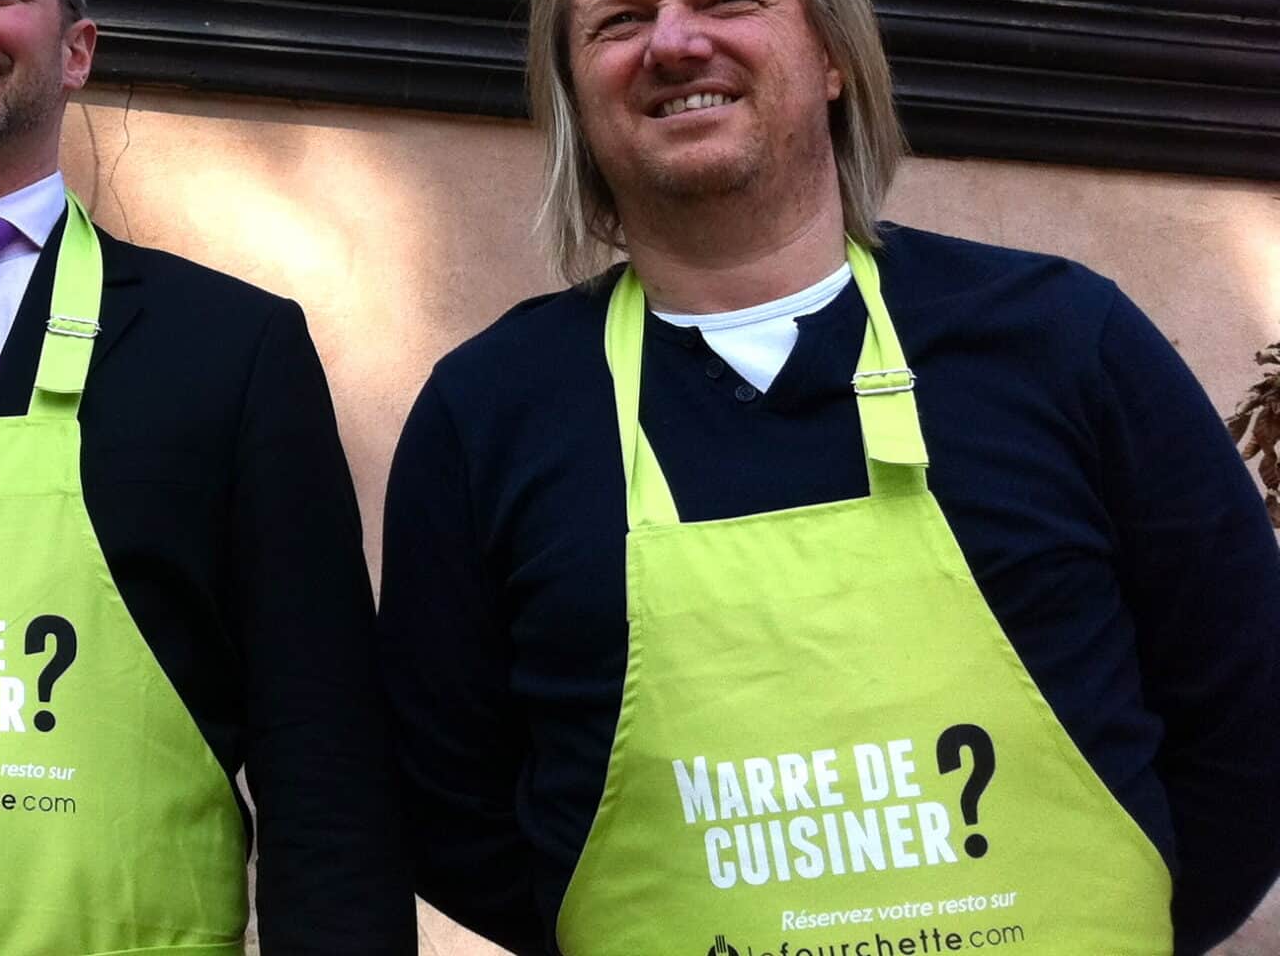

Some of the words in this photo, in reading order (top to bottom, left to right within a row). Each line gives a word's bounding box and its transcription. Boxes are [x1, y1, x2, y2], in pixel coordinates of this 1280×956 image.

[0, 761, 45, 779] resto
[48, 764, 76, 781] sur
[852, 738, 921, 804] DE
[703, 801, 959, 890] CUISINER
[780, 907, 874, 932] Réservez
[877, 899, 934, 921] votre
[937, 893, 989, 915] resto
[990, 890, 1017, 908] sur
